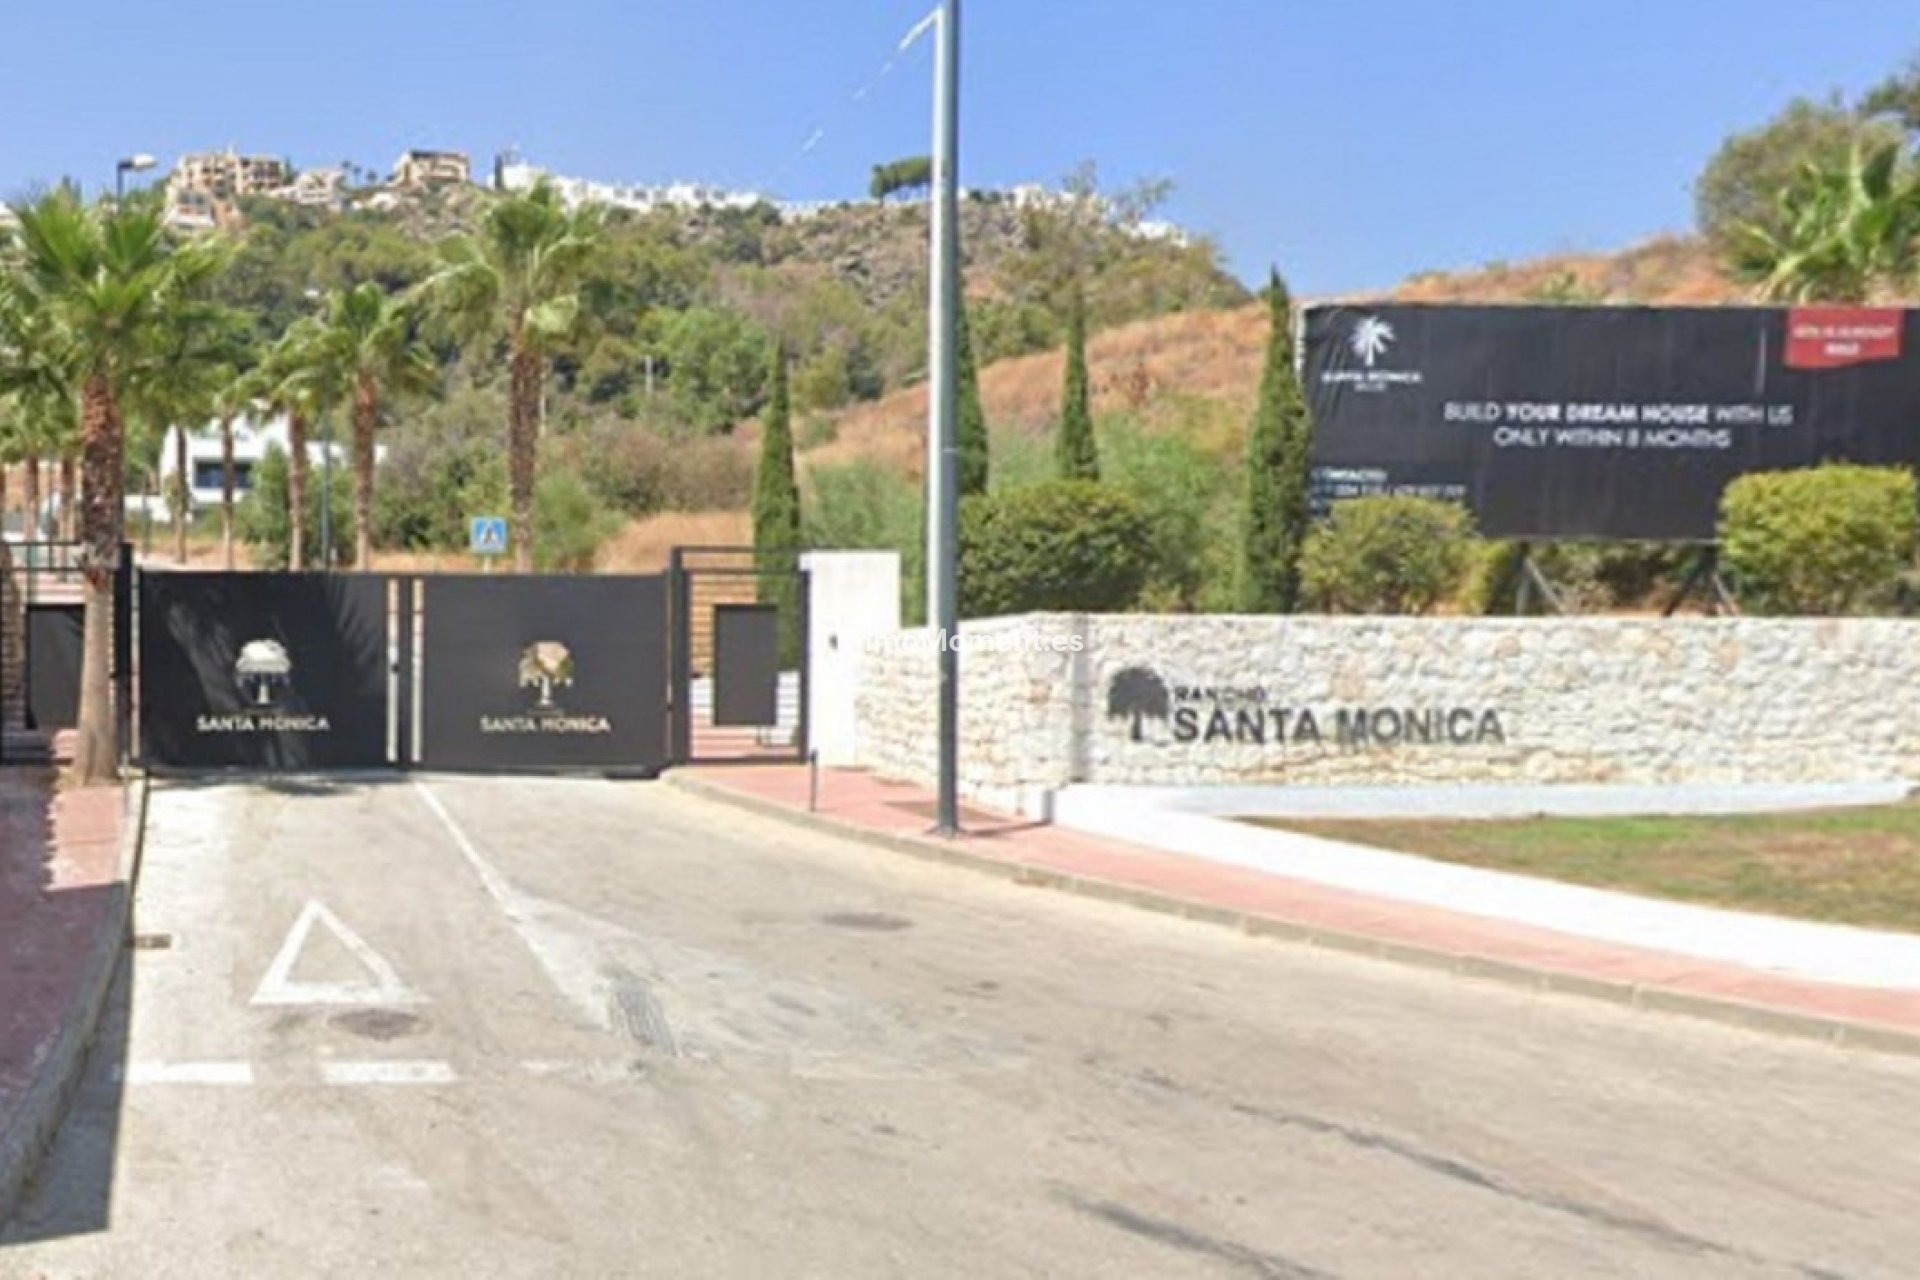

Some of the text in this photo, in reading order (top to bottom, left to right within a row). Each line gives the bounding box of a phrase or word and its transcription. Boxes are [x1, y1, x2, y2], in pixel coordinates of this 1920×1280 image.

[1443, 401, 1793, 426] BUILD YOUR DREAM HOUSE WITH US
[1493, 426, 1550, 447] ONLY
[1554, 427, 1623, 447] WITHIN
[1643, 427, 1731, 449] MONTHS
[196, 713, 331, 732] SANTA MONICA
[479, 714, 612, 734] SANTA MONICA
[1173, 707, 1505, 745] SANTA MONICA
